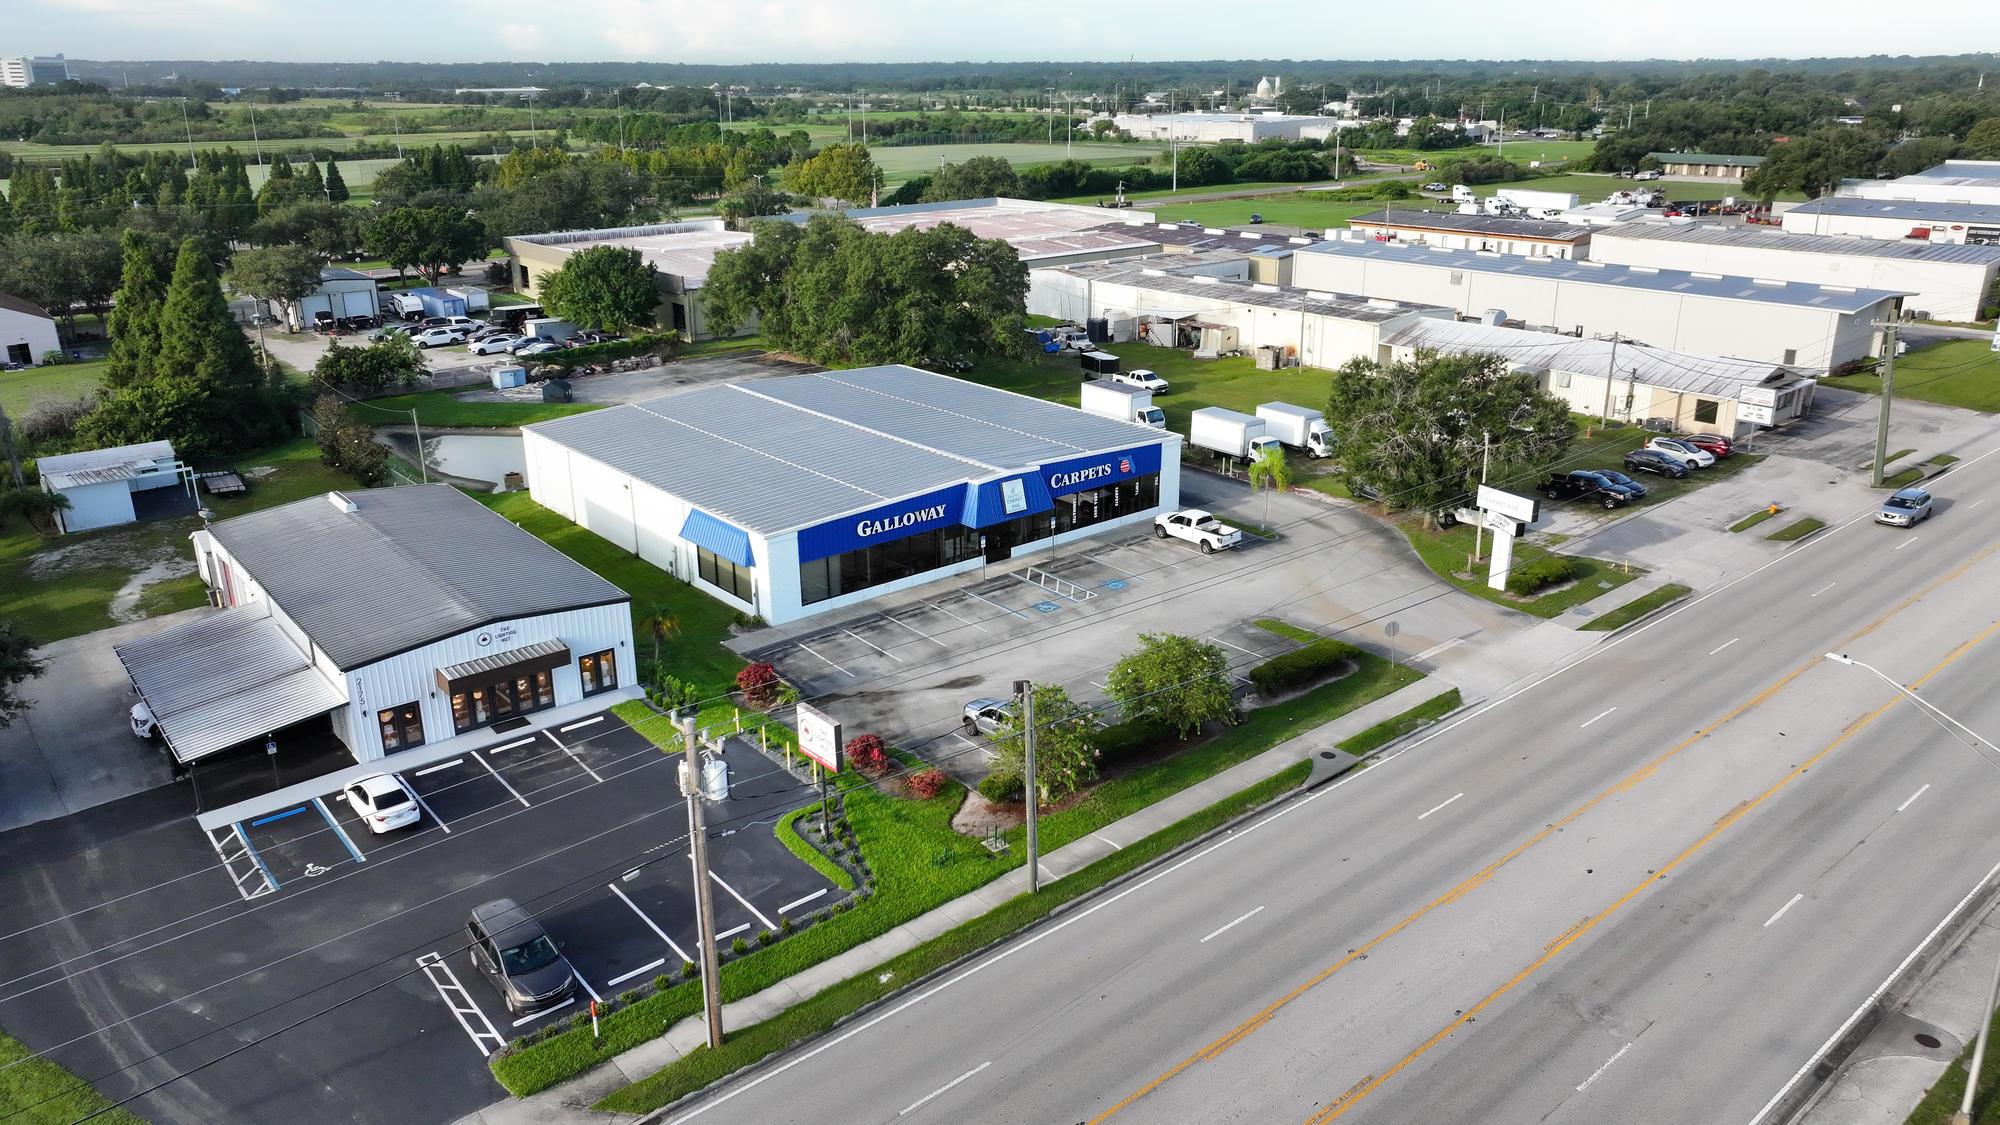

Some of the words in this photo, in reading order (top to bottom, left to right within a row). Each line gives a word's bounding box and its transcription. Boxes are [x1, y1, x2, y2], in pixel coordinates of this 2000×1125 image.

[857, 504, 946, 537] GALLOWAY
[1051, 463, 1112, 489] CARPETS
[356, 677, 366, 705] 2175
